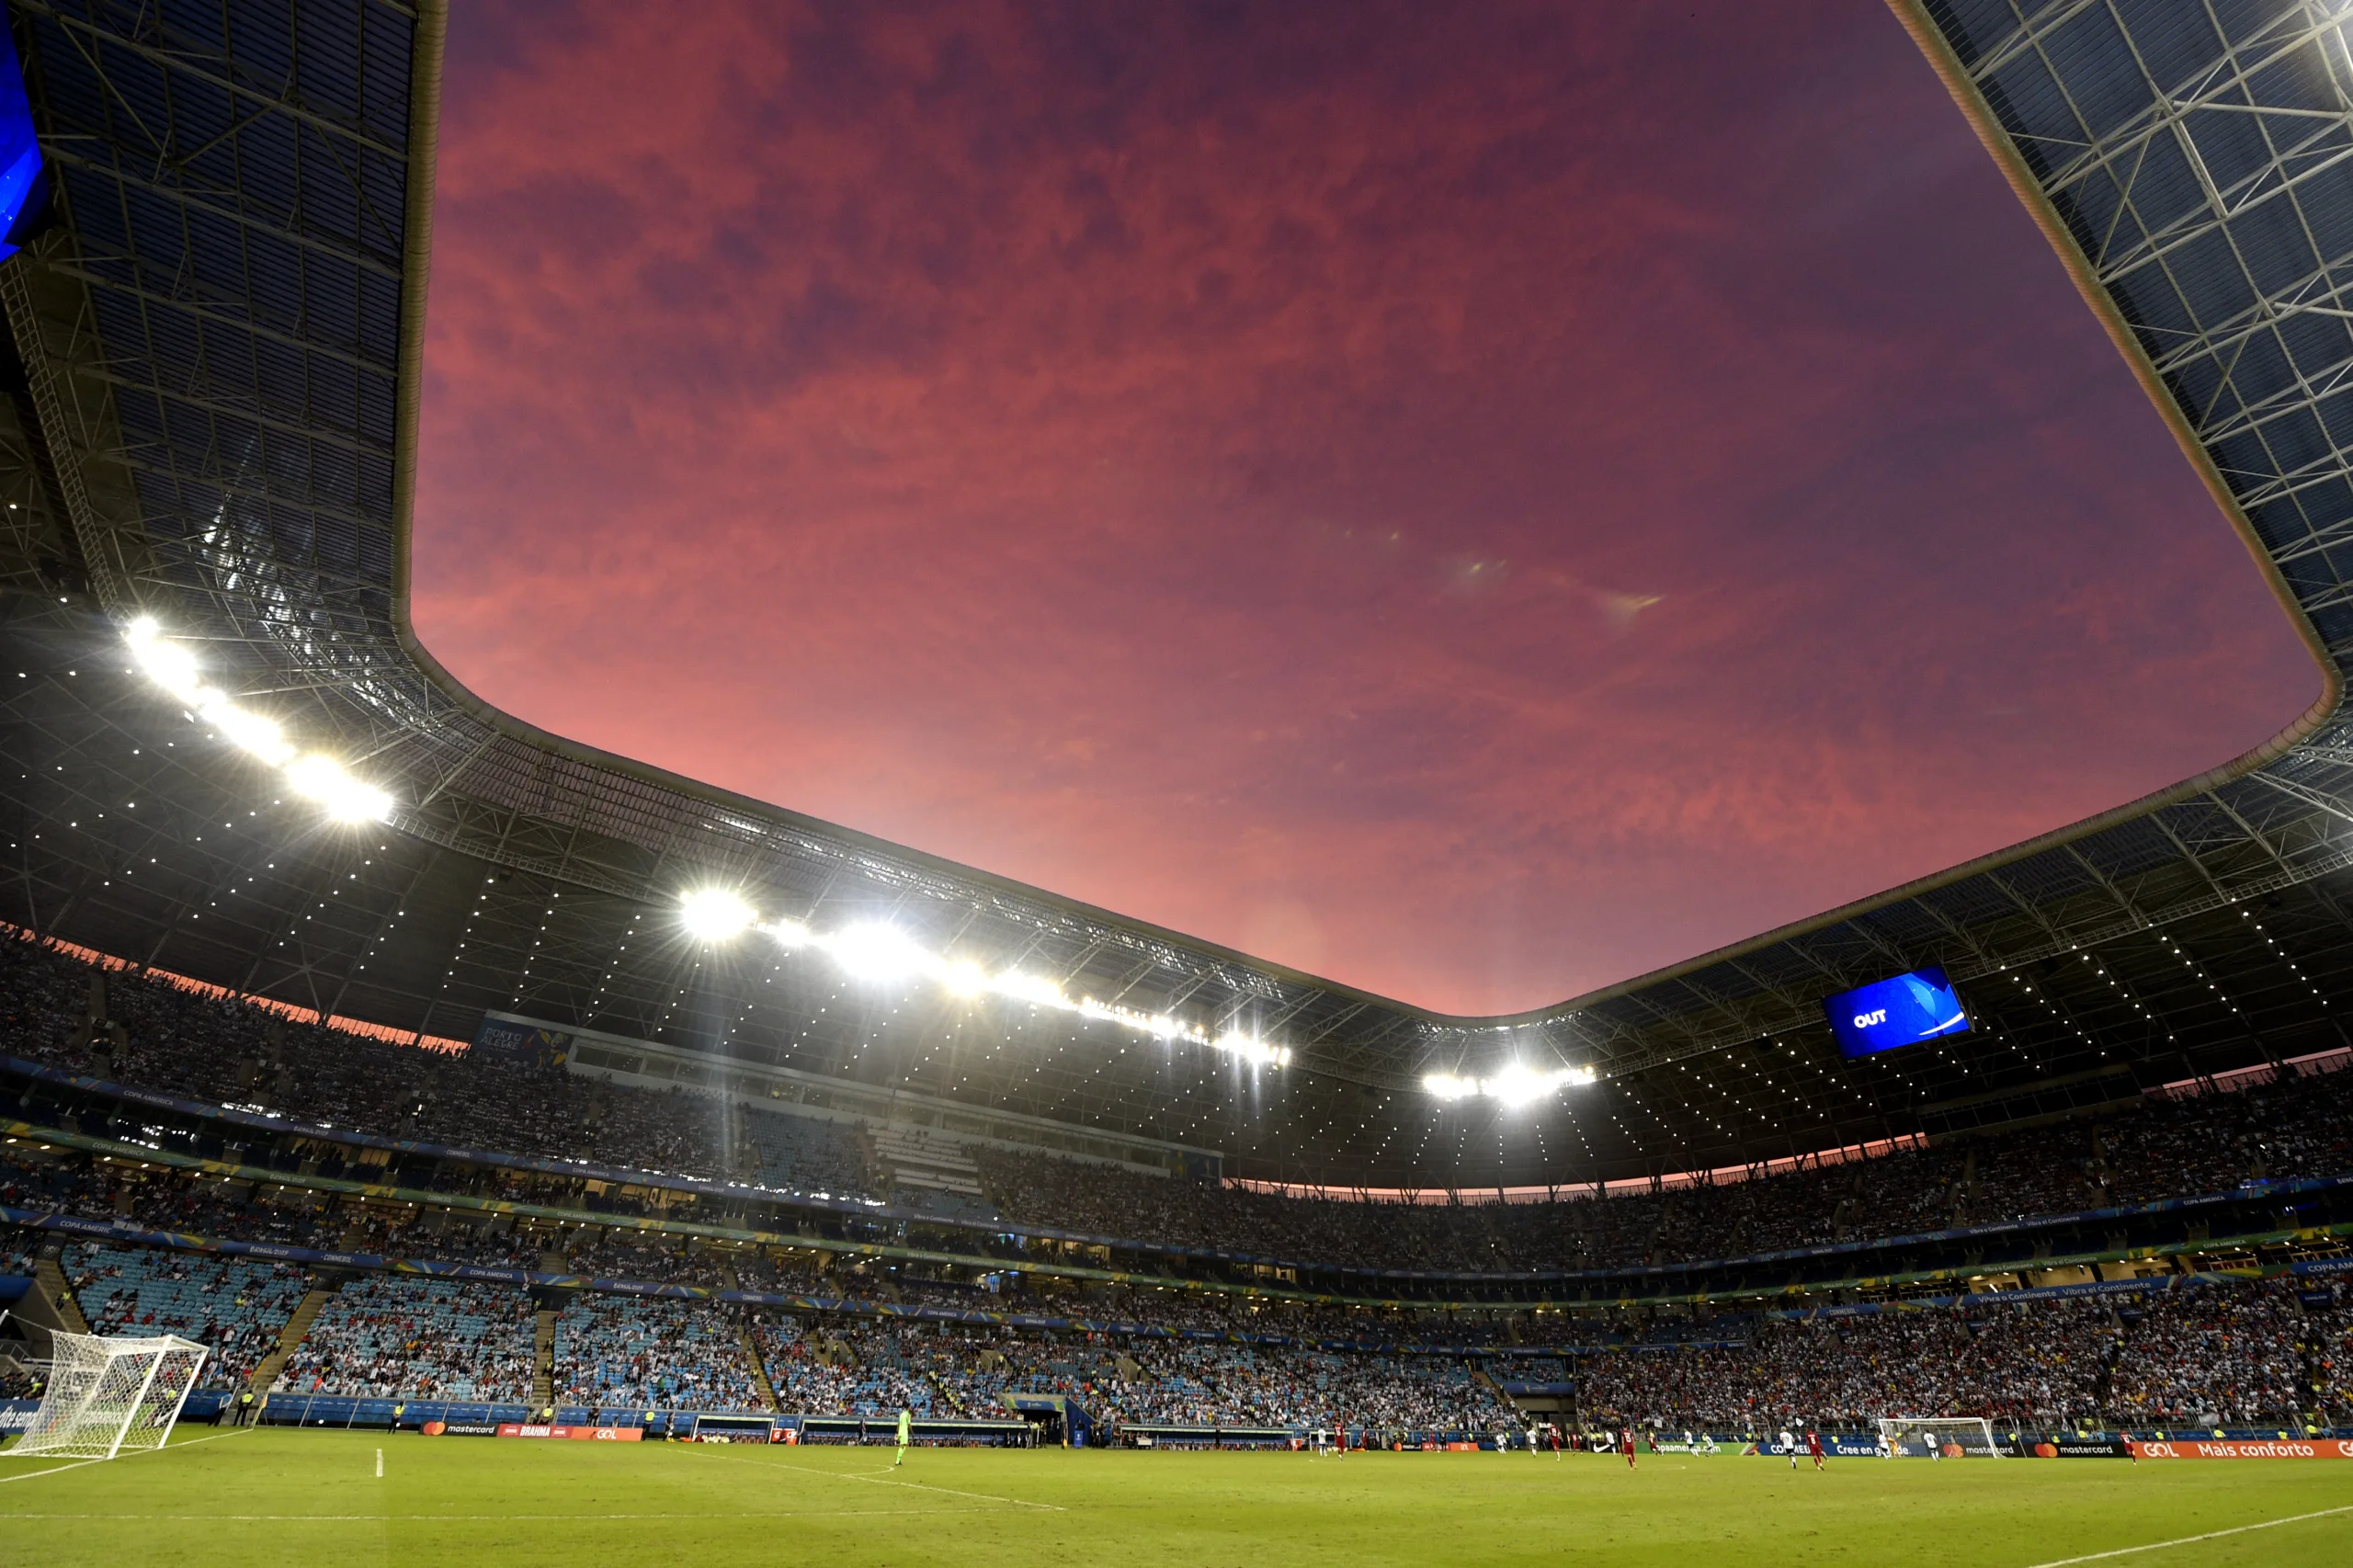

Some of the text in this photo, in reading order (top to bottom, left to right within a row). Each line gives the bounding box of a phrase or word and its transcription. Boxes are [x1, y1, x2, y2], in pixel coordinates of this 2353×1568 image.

[1854, 1009, 1886, 1028] OUT
[485, 1028, 522, 1042] PORTO
[479, 1036, 520, 1051] ALEGRE
[123, 1090, 142, 1099] COPA
[93, 1142, 111, 1151] COPA
[2200, 1196, 2226, 1204] AMERICA
[2048, 1216, 2080, 1224] Continente
[60, 1221, 112, 1233] COPA AMERIC
[1988, 1223, 2018, 1233] Continente
[2220, 1239, 2246, 1247] AMERICA
[324, 1254, 352, 1264] CONMEBOL
[470, 1268, 486, 1278] COPA
[2307, 1263, 2336, 1273] COPA
[2063, 1282, 2151, 1296] Vibra el Continente
[2008, 1290, 2057, 1301] Continente
[1828, 1308, 1857, 1316] CONMEBOL
[448, 1424, 494, 1434] mastercard
[519, 1426, 551, 1437] BRAHMA
[597, 1429, 617, 1440] GOL
[1836, 1445, 1859, 1455] Cree
[1860, 1447, 1873, 1455] en
[1966, 1445, 2014, 1454] mastecard
[2060, 1444, 2113, 1455] mastercard
[2143, 1442, 2314, 1458] GOL Mais conforto
